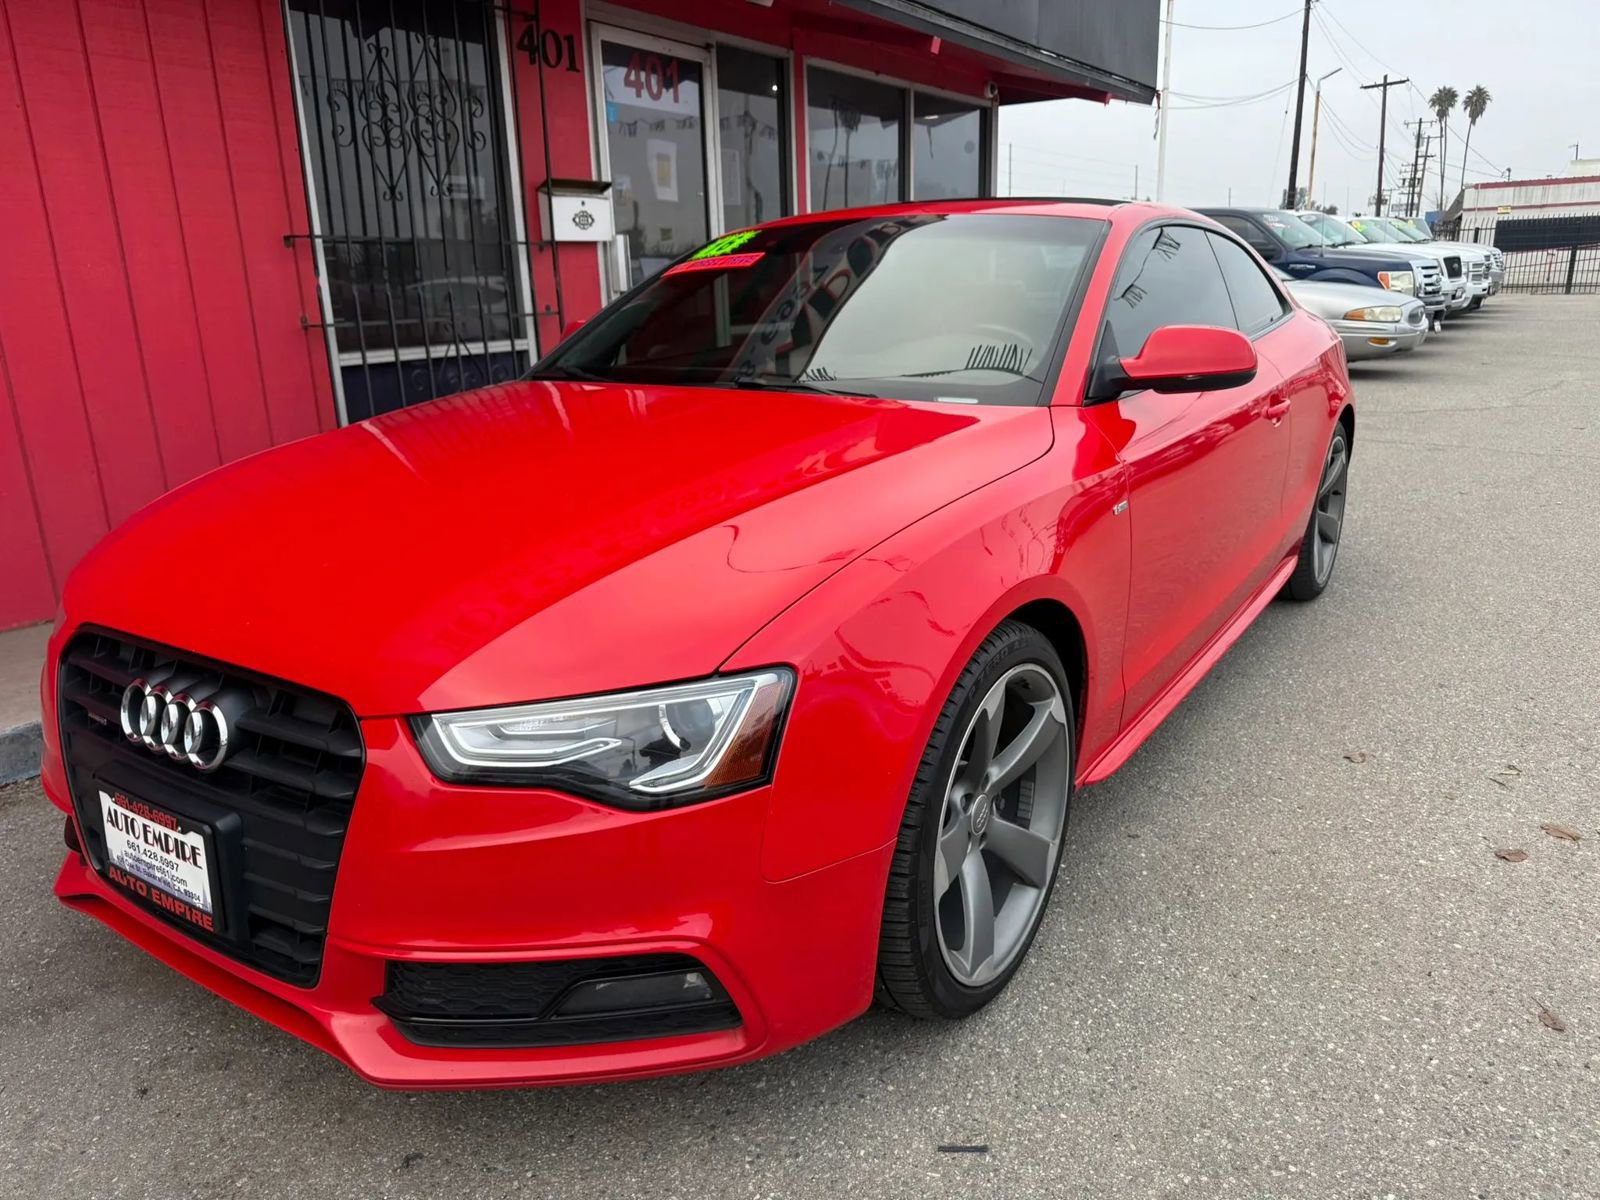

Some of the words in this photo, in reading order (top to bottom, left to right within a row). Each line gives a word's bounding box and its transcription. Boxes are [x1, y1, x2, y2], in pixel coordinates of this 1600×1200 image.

[516, 24, 581, 73] 401
[624, 52, 679, 104] 401
[106, 805, 140, 840] AUTO
[142, 823, 203, 870] EMPIRE
[109, 863, 149, 897] AUTO
[151, 887, 214, 931] EMPIRE
